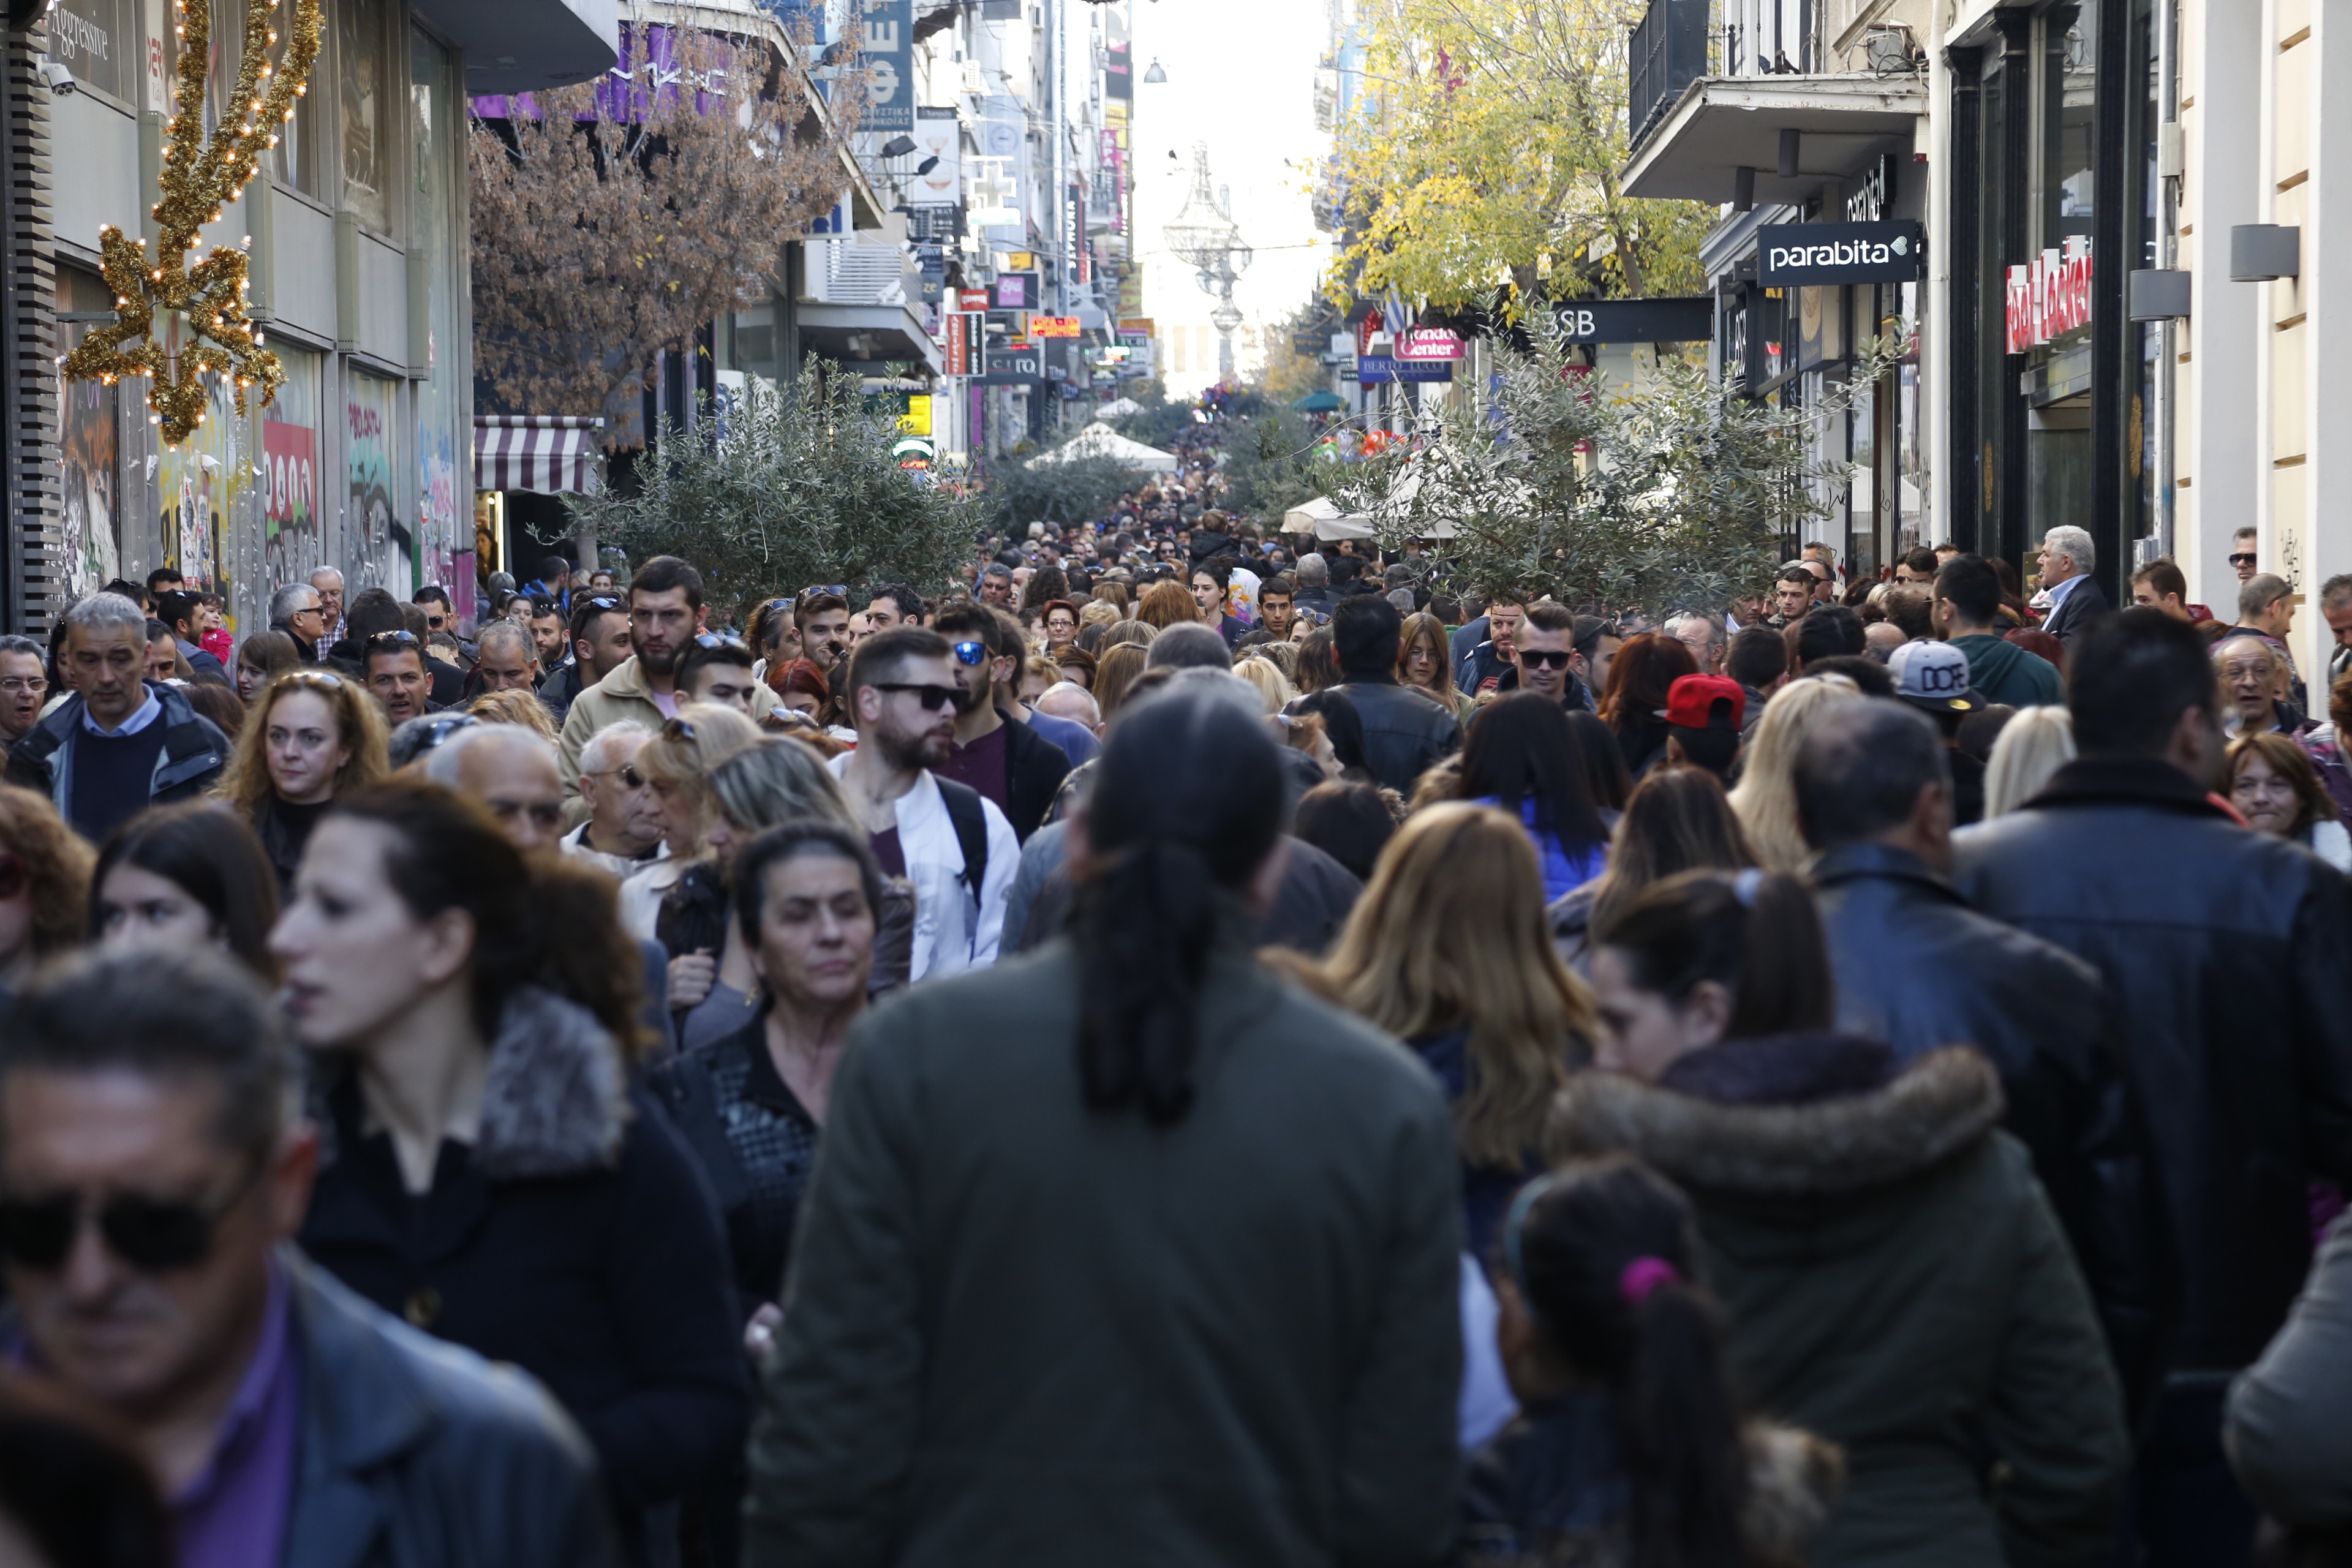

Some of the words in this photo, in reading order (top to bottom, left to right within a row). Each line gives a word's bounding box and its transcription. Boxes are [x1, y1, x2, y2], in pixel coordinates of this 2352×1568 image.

[52, 2, 108, 60] Aggressive
[859, 108, 910, 116] ΚΟΥΣΤΙΚΑ
[1066, 200, 1077, 269] SEPHORA
[1770, 239, 1889, 271] parabita
[1542, 310, 1595, 336] BSB
[1400, 341, 1455, 356] Center
[1364, 361, 1402, 371] BERTO
[1410, 361, 1444, 371] LUCCI
